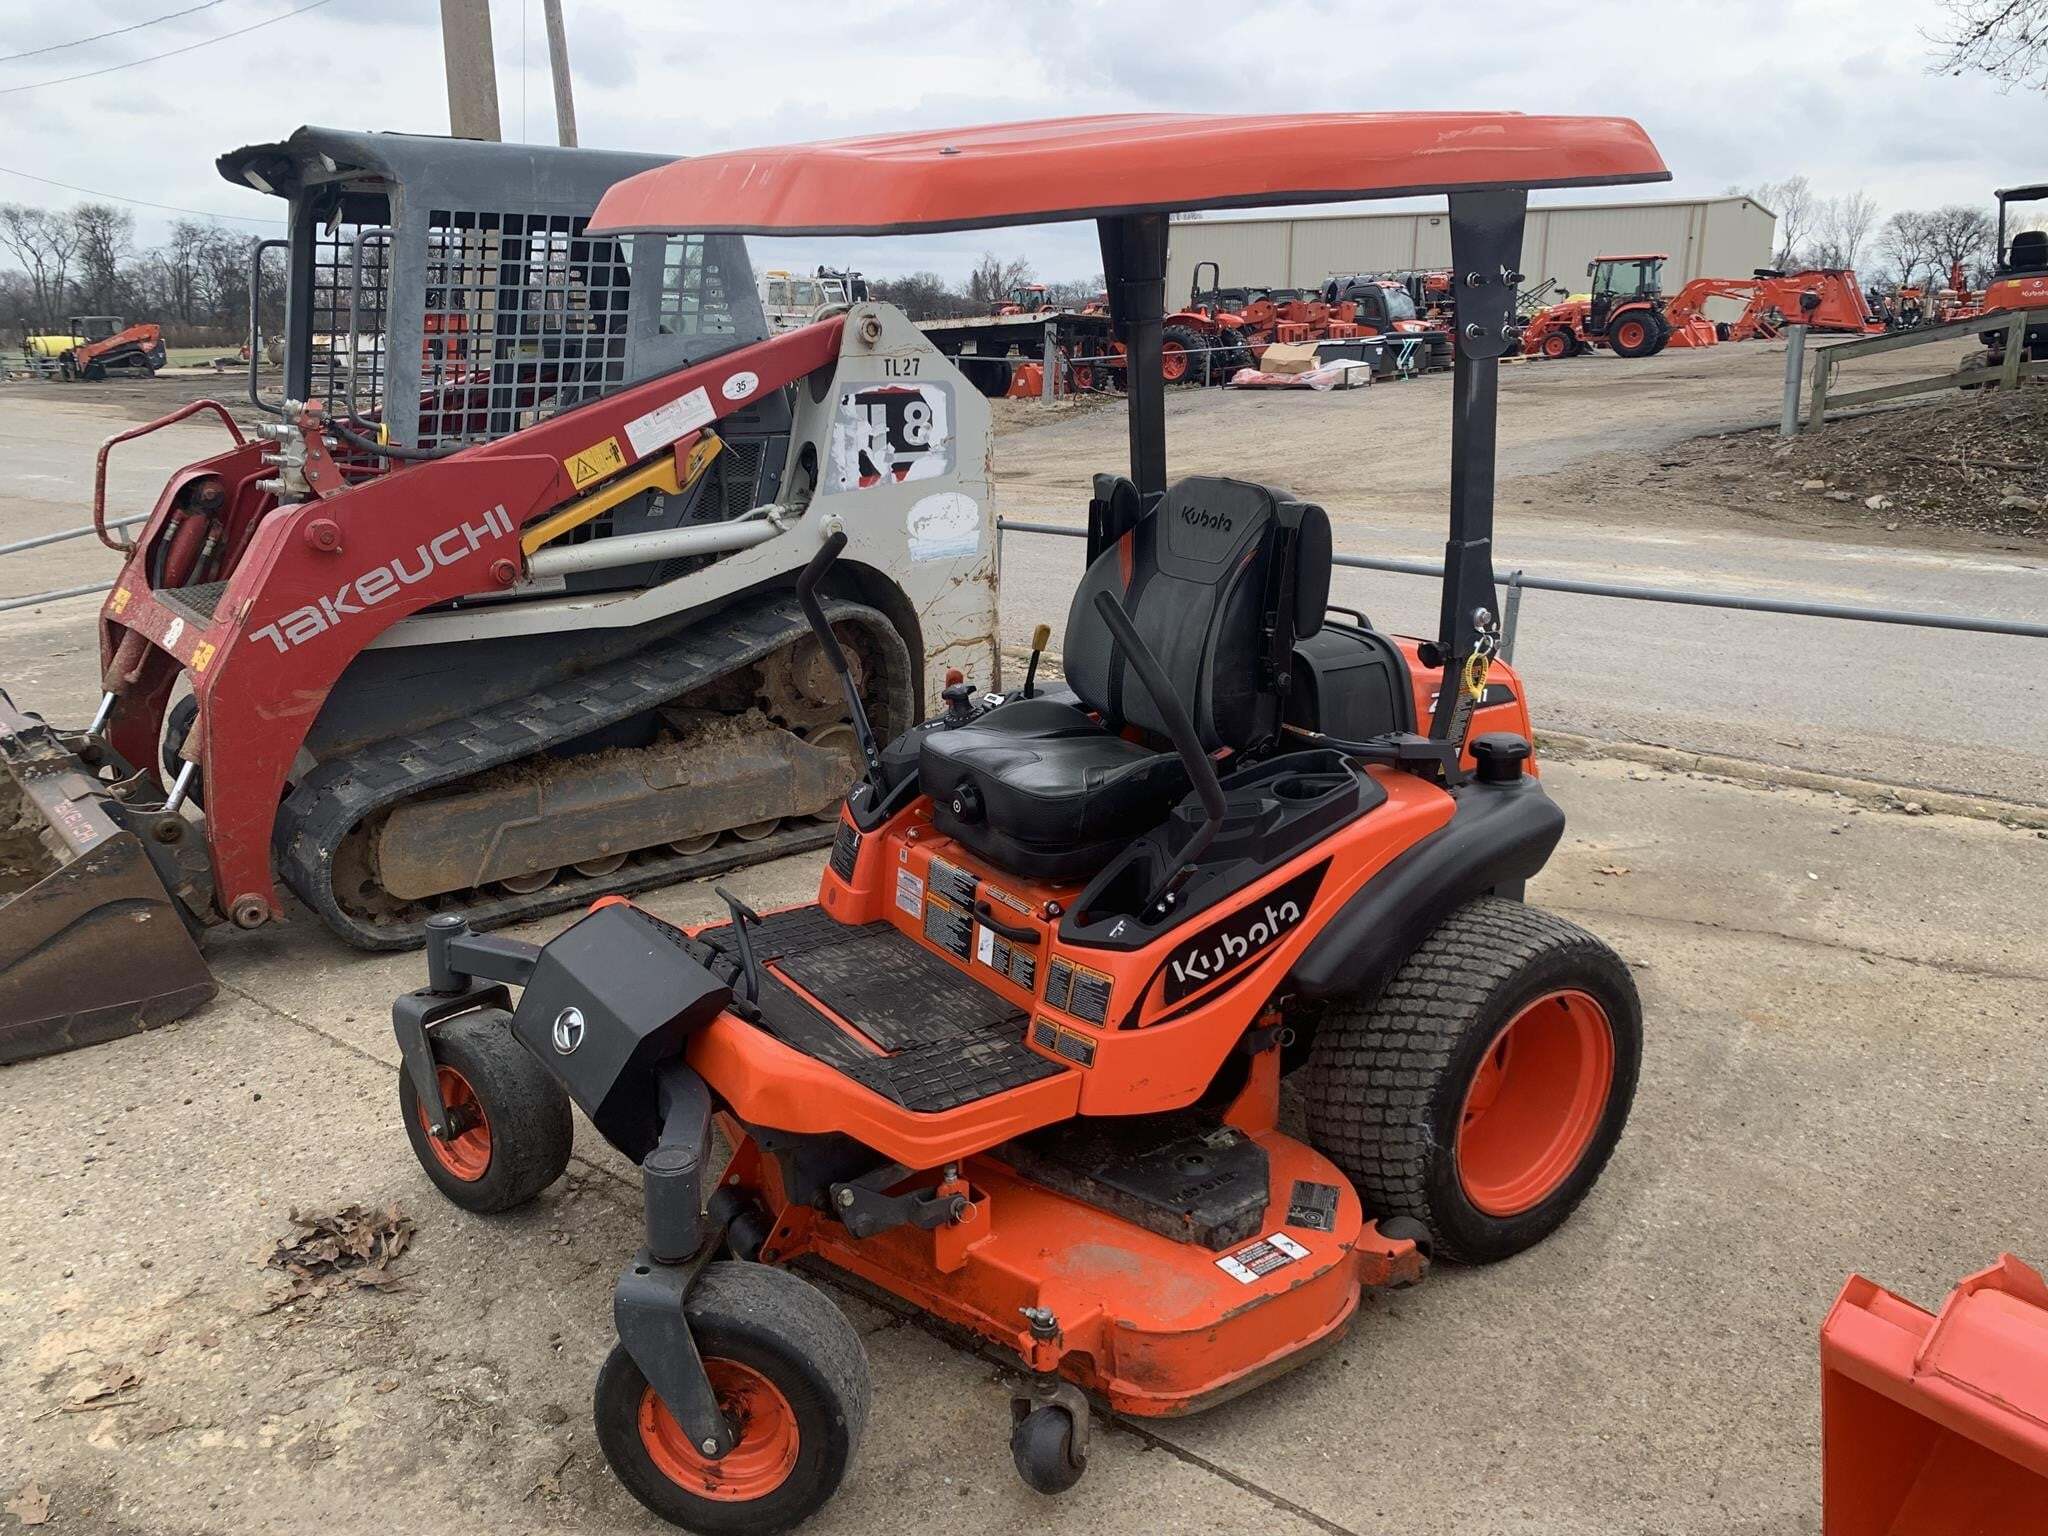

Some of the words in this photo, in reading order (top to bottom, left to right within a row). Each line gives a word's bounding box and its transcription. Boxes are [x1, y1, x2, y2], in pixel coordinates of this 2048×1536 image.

[884, 358, 920, 377] TL27
[736, 380, 747, 393] 35
[1181, 505, 1232, 532] Kubota
[1171, 900, 1301, 983] Kubota
